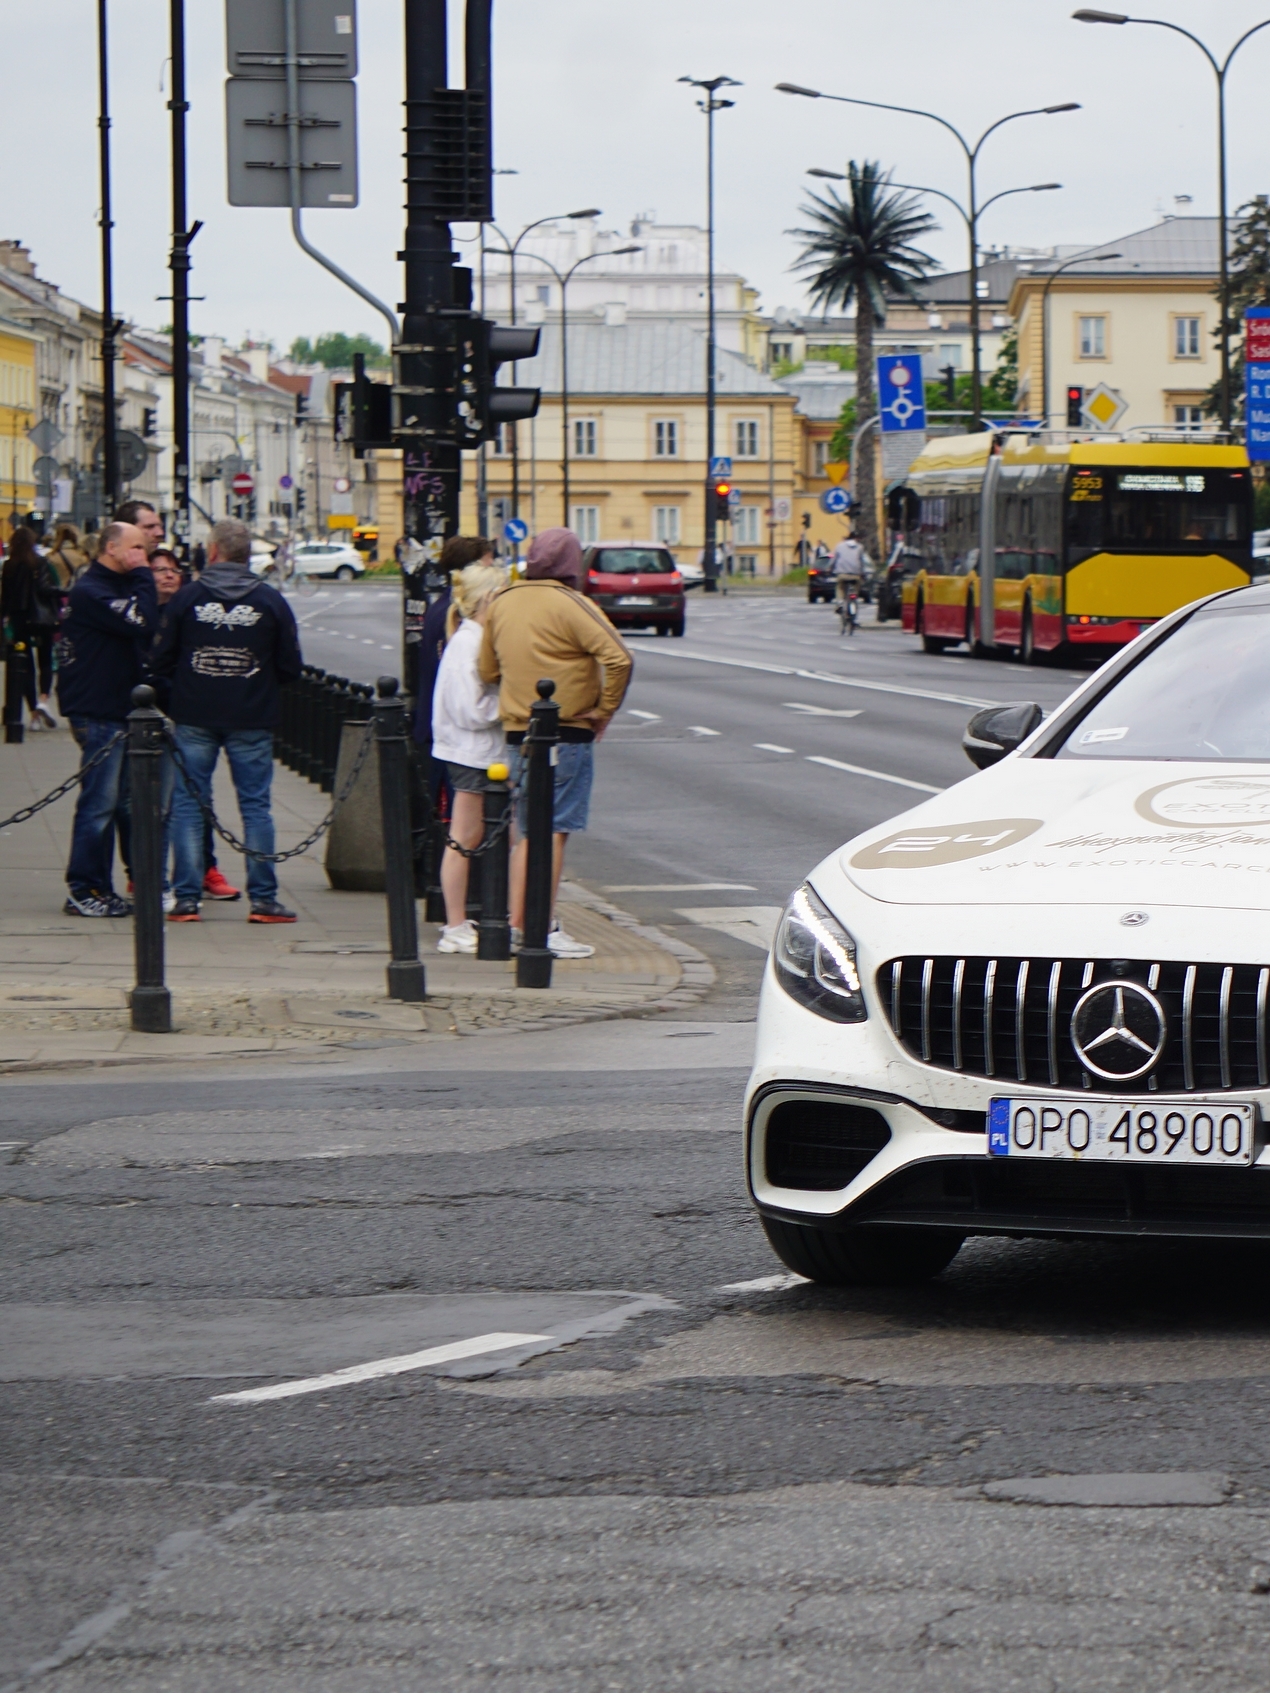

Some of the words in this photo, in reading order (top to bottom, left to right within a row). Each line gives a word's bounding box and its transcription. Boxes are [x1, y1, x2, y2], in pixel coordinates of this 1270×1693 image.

[1251, 385, 1262, 399] R.
[1072, 477, 1103, 489] 5953
[877, 830, 1019, 854] 24
[1013, 1105, 1090, 1152] OPO
[1108, 1109, 1243, 1157] 48900
[991, 1133, 1008, 1147] PL
